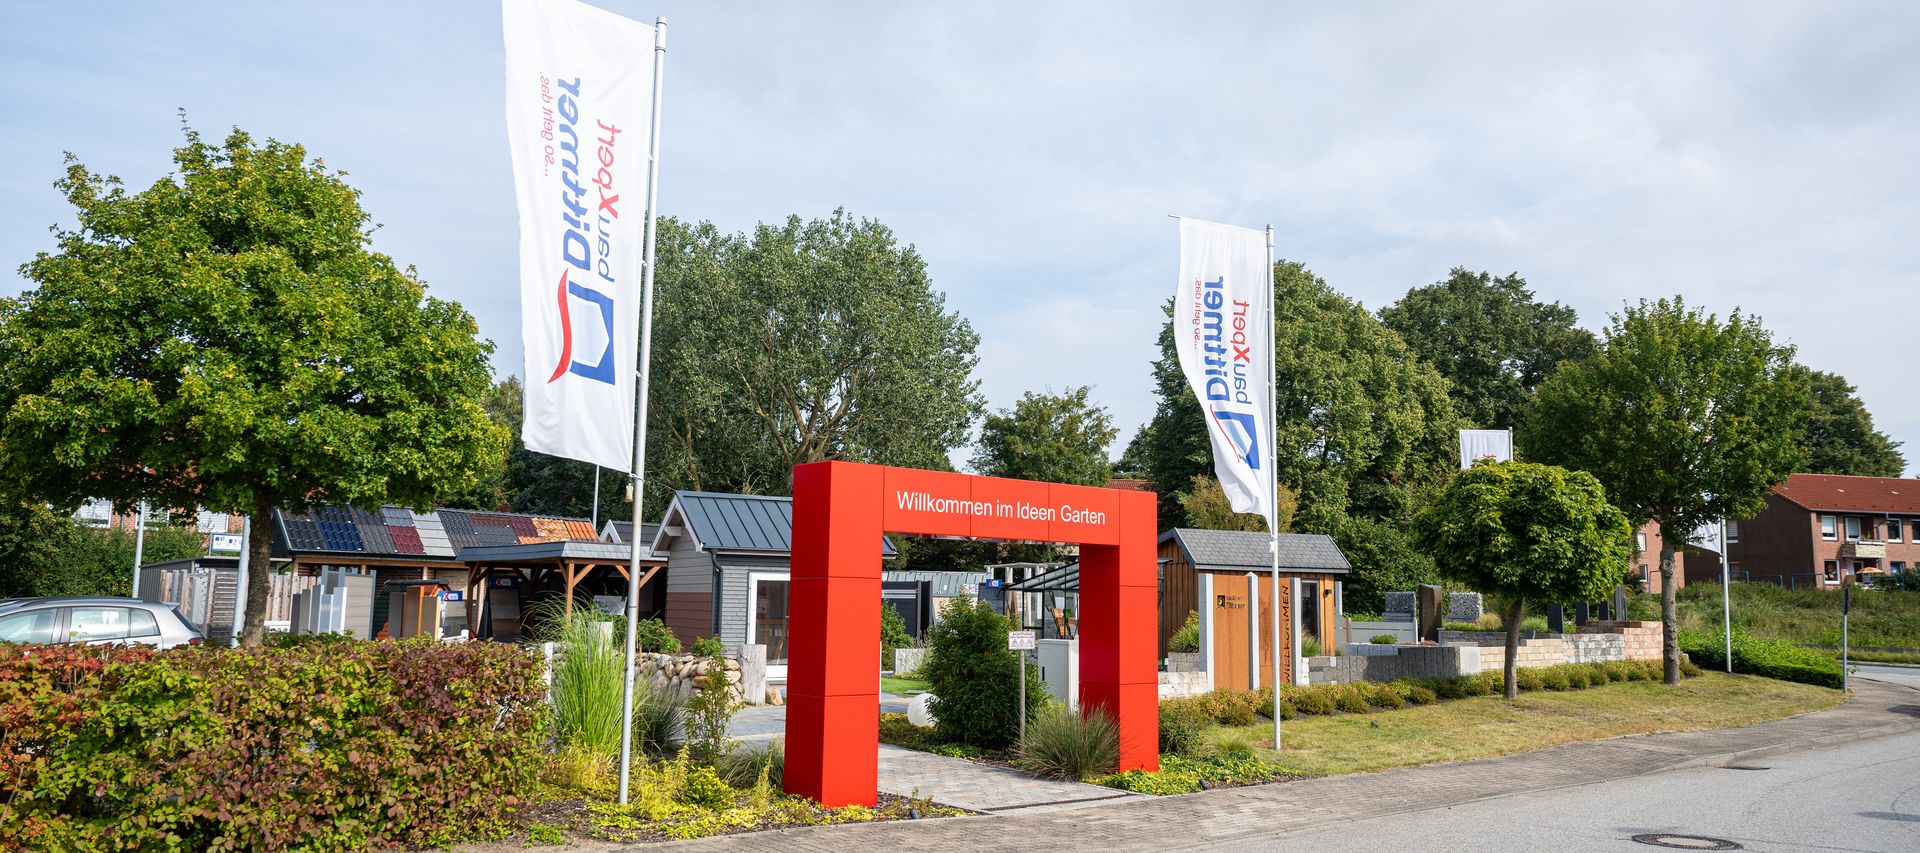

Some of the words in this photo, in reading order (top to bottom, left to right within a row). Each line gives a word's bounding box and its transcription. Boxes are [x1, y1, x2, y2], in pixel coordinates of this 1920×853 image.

[897, 491, 992, 516] Willkommen
[997, 500, 1013, 518] im
[1017, 501, 1056, 521] Ideen
[1060, 505, 1106, 525] Garten
[1282, 586, 1290, 683] WILLKOMMEN
